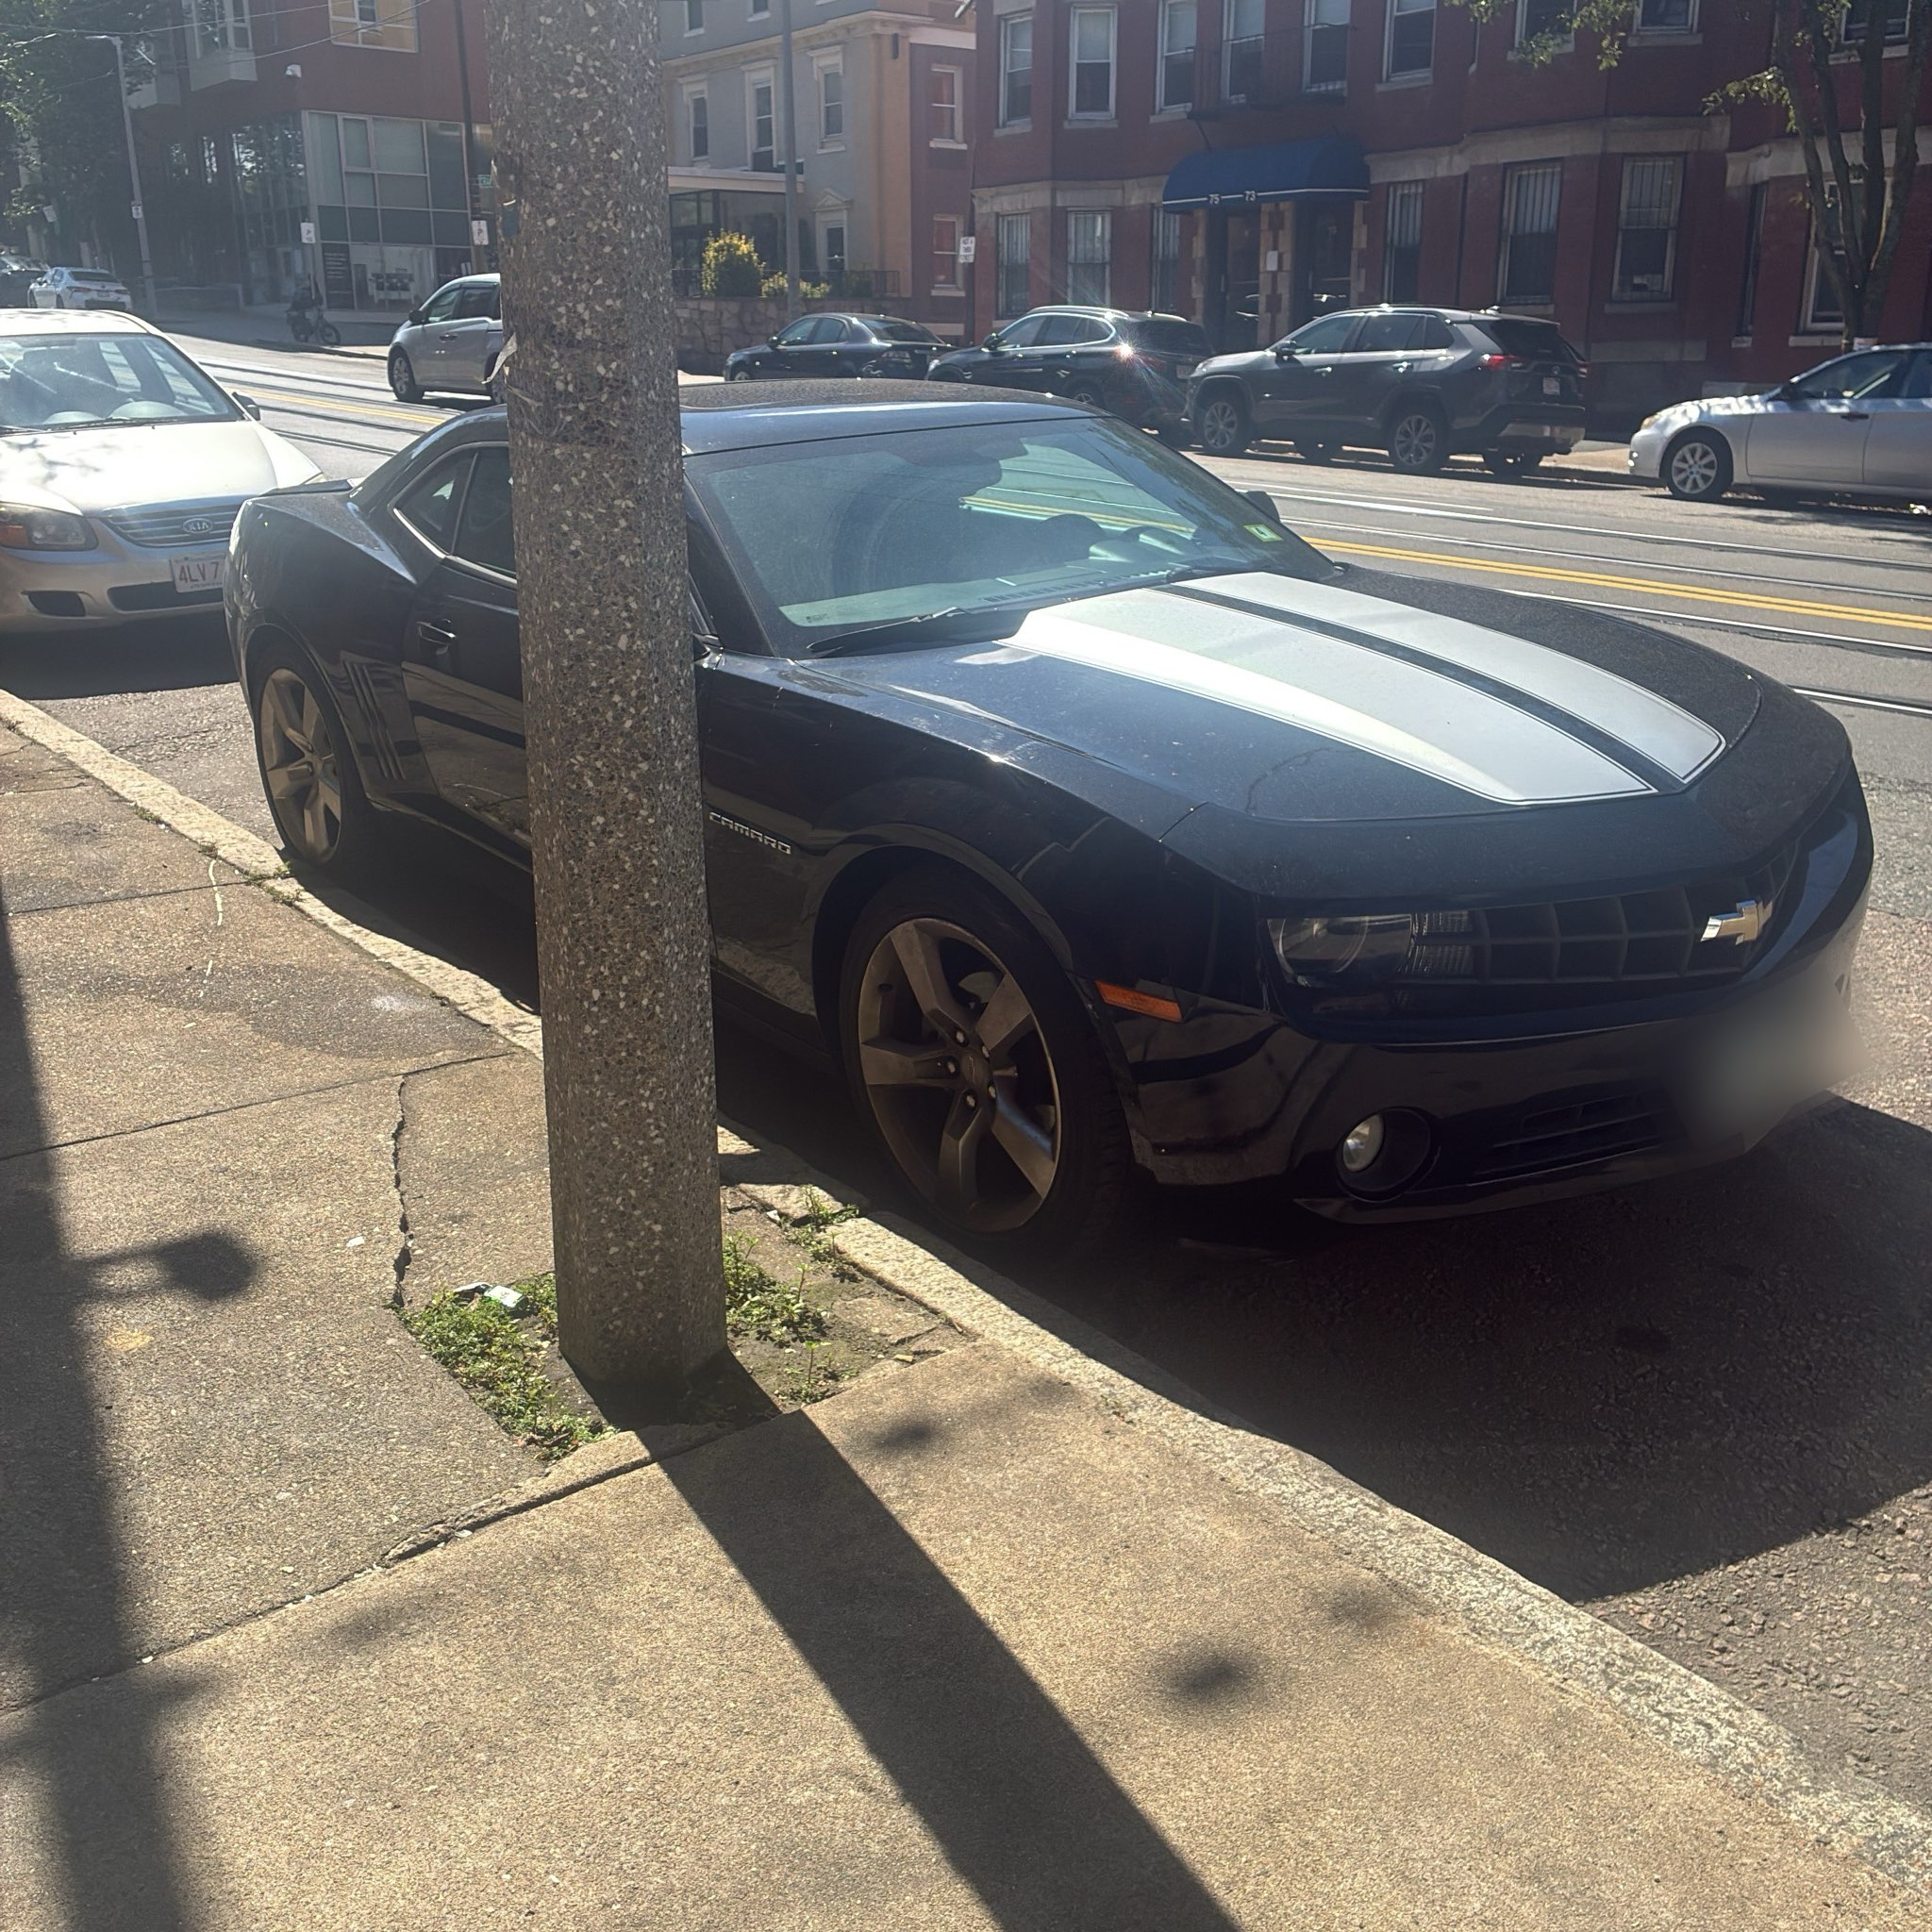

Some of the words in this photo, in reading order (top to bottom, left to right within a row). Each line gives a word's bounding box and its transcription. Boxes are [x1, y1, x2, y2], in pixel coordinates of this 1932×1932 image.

[1208, 193, 1220, 205] 75
[1245, 190, 1256, 202] 73
[189, 521, 209, 532] KIA
[178, 562, 207, 584] 4LV
[708, 811, 791, 855] CAMARO
